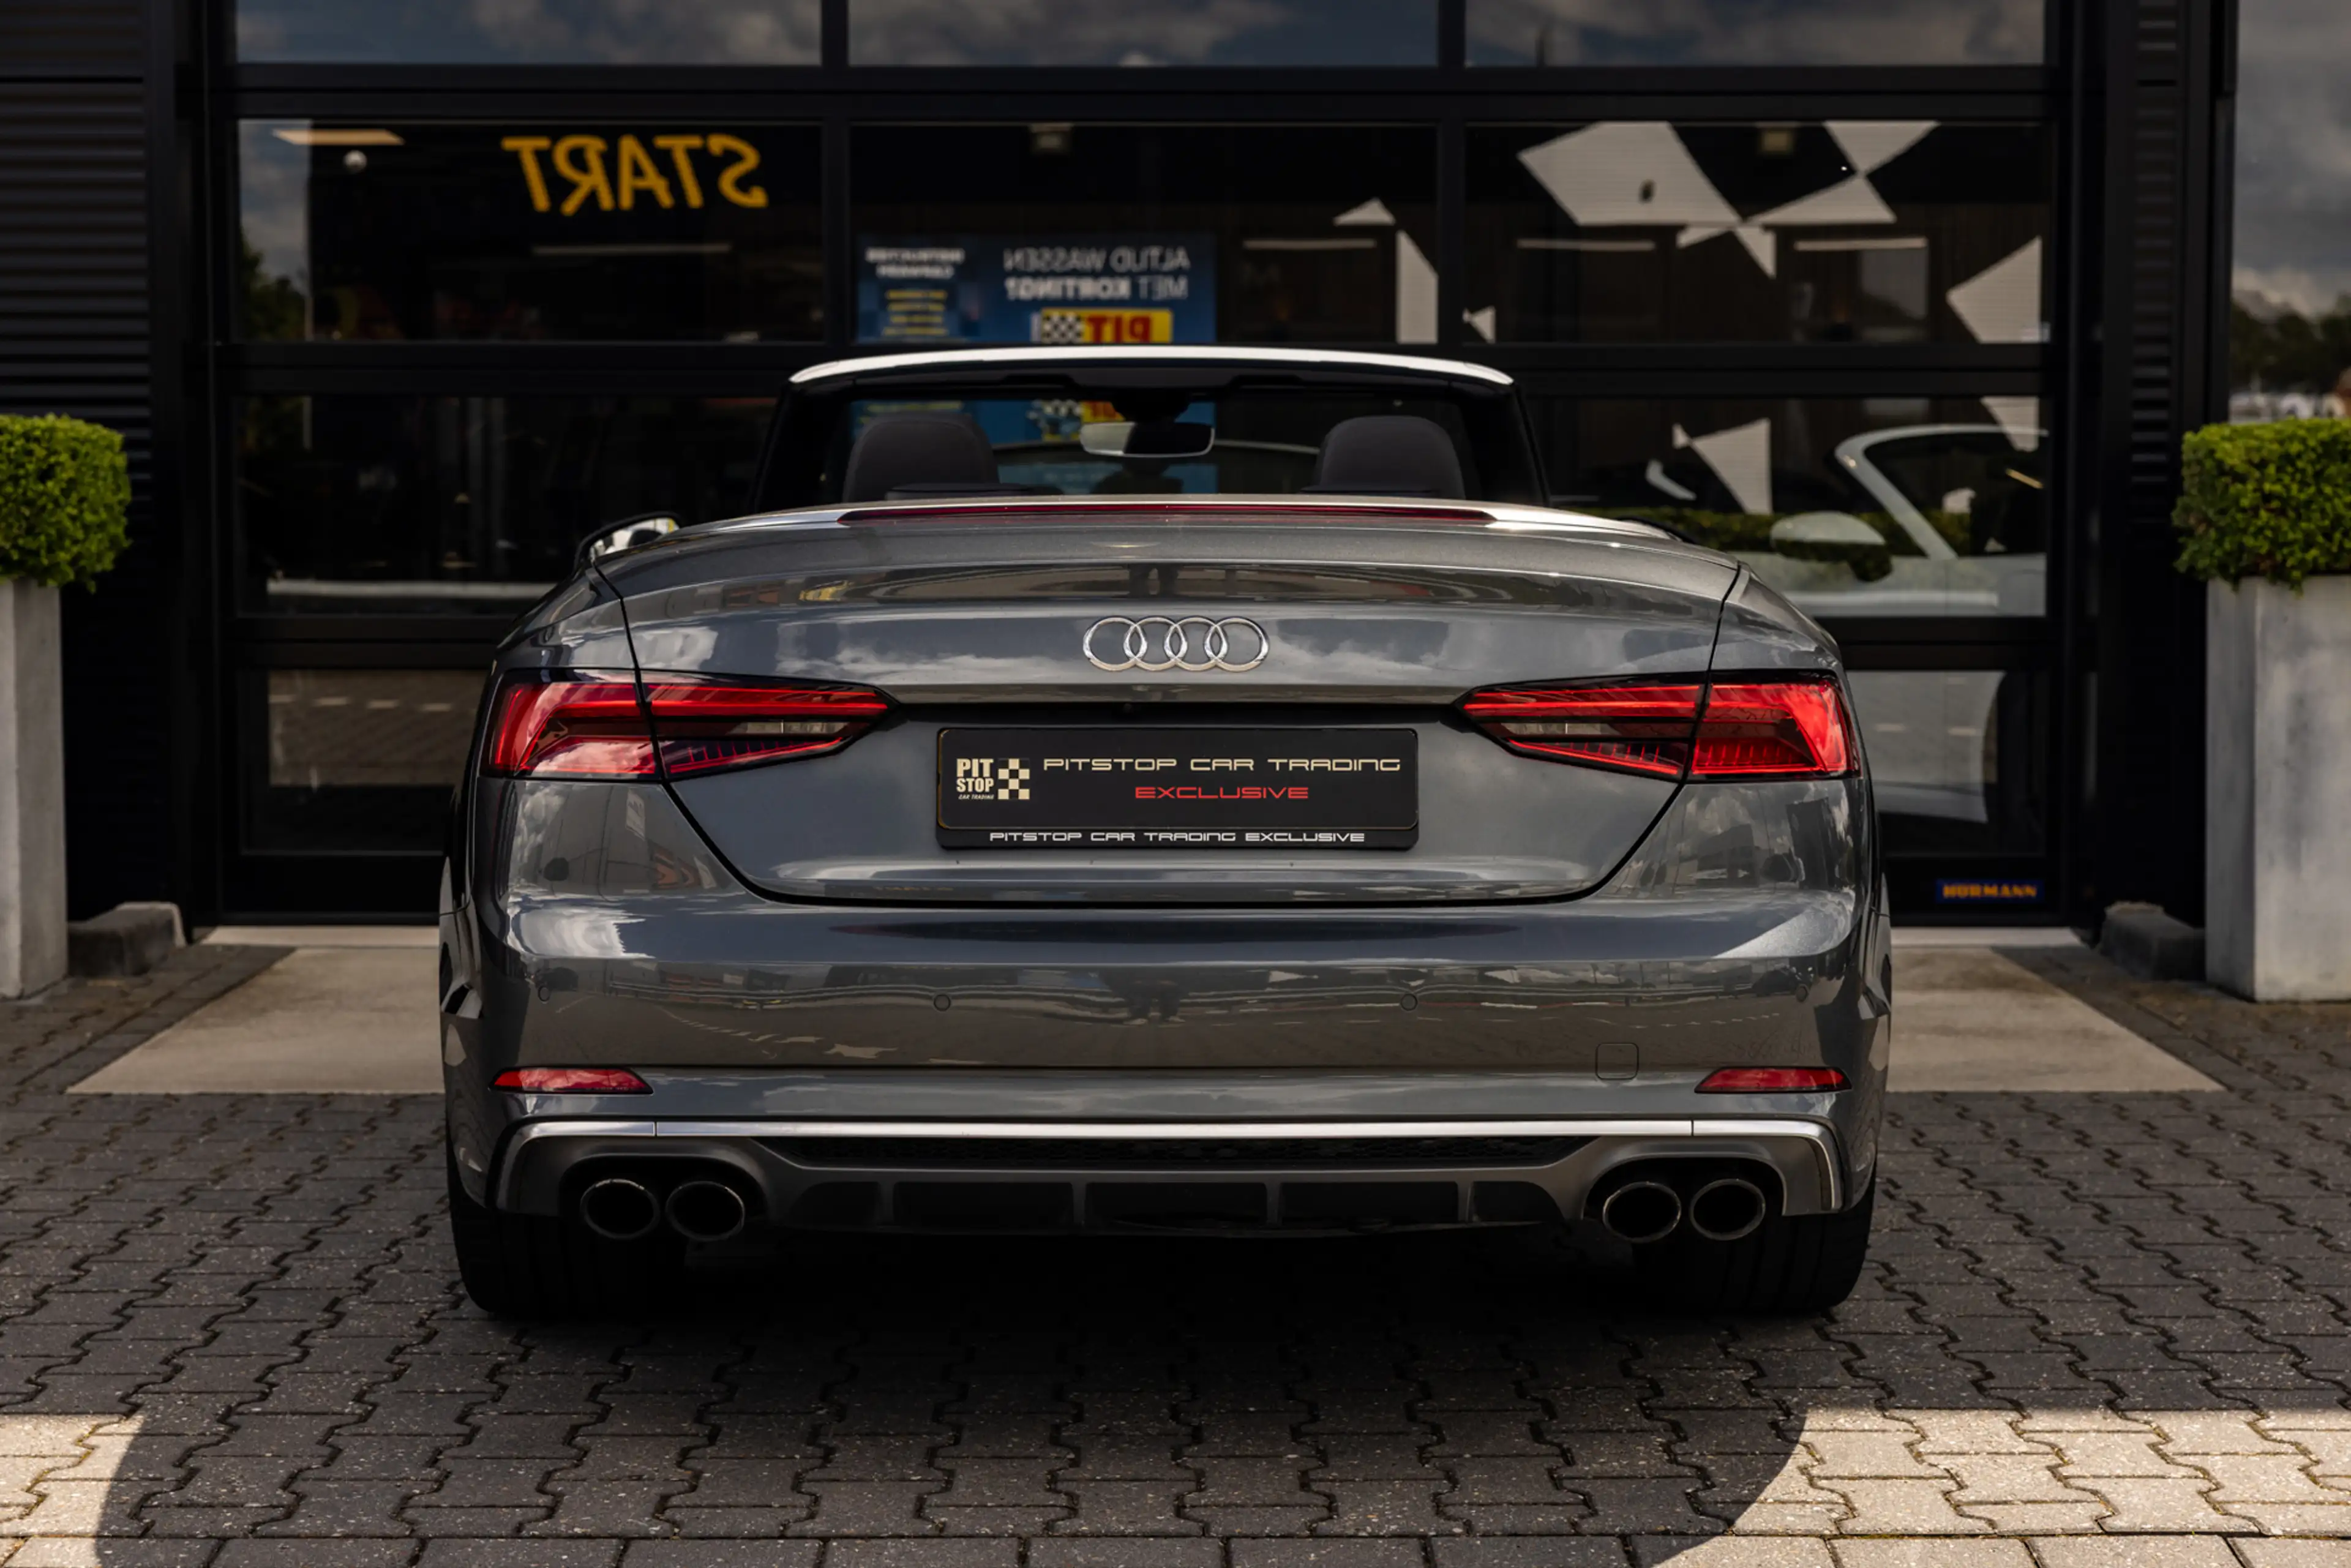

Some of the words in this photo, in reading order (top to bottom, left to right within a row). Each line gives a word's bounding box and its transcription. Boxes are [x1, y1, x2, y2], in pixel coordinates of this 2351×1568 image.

[956, 759, 994, 778] PIT
[1043, 759, 1177, 771] PITSTOP
[1190, 759, 1254, 771] CAR
[1267, 759, 1400, 771] TRADING
[956, 778, 994, 793] STOP
[1135, 786, 1308, 799] EXCLUSIVE
[989, 832, 1082, 841] PITSTOP
[1090, 832, 1135, 841] CAR
[1144, 832, 1236, 841] TRADING
[1245, 833, 1365, 842] EXCLUSIVE
